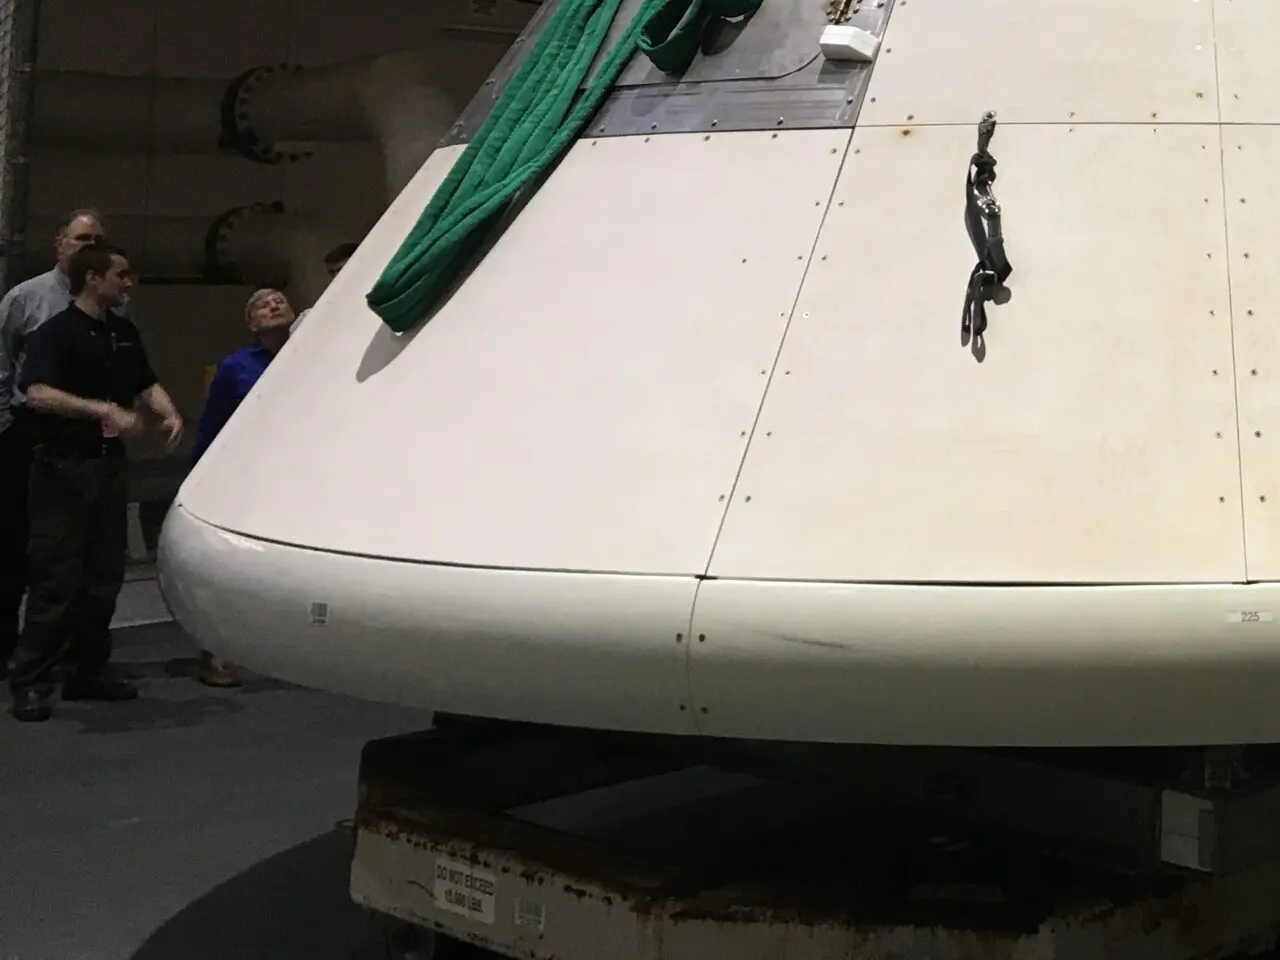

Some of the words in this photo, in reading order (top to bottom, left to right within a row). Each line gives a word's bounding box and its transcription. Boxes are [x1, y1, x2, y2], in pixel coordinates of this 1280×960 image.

[1241, 611, 1260, 622] 225
[448, 869, 464, 886] NOT
[464, 874, 495, 896] EXCEED
